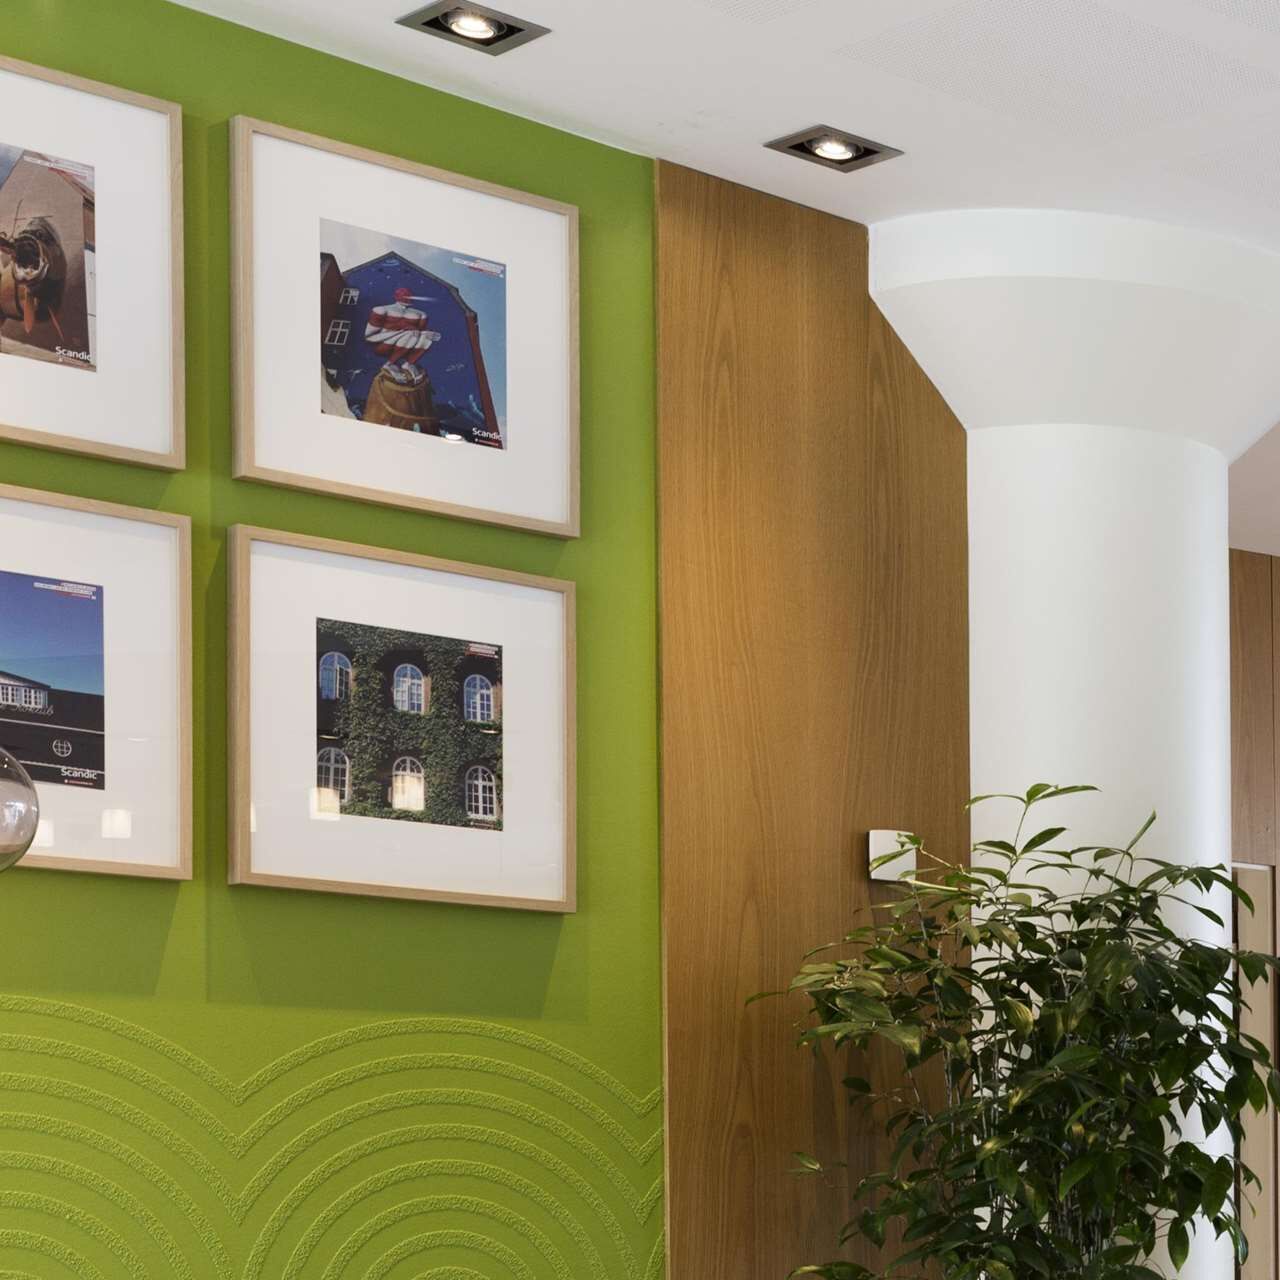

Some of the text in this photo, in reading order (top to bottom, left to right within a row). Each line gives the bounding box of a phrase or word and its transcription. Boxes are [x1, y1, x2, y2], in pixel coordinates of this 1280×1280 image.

[55, 346, 93, 361] Scandic
[472, 427, 504, 441] Scandic
[60, 766, 97, 780] Scandic
